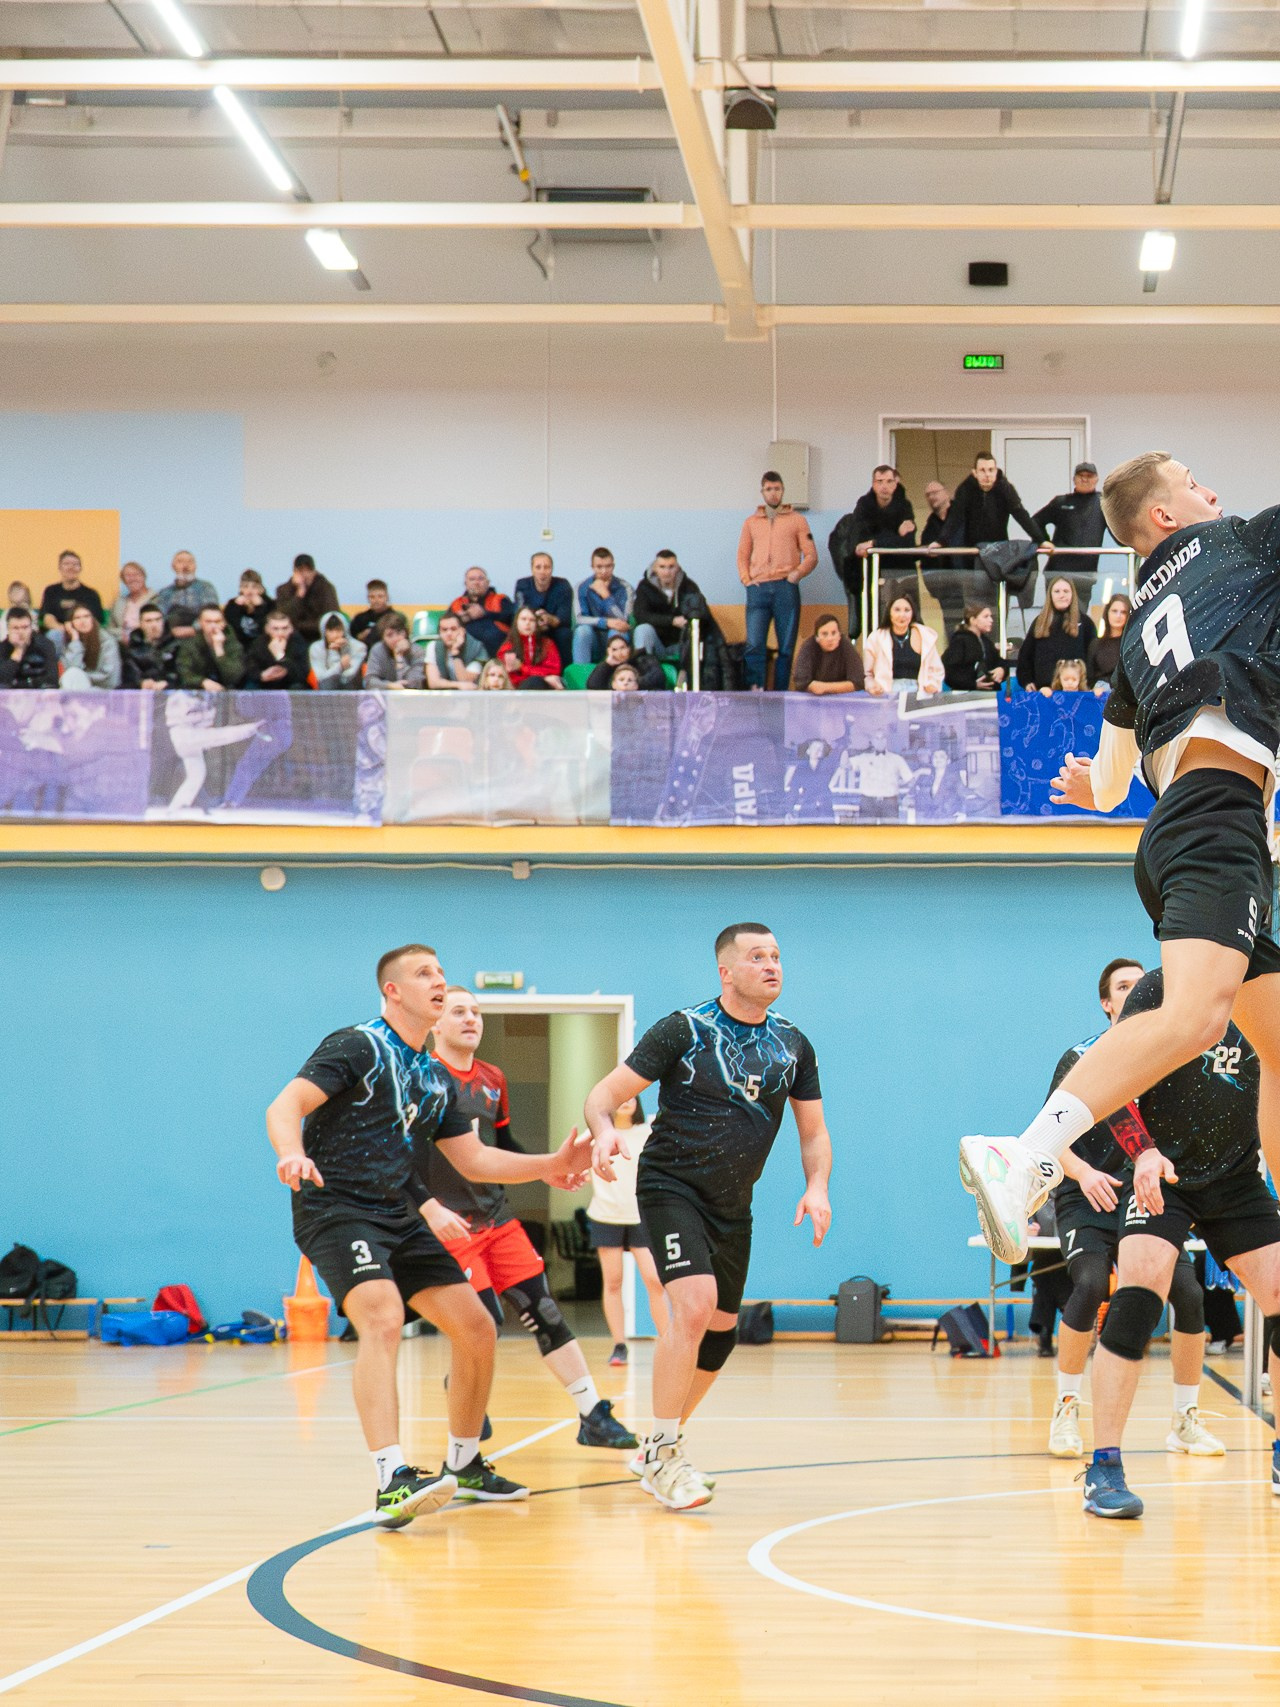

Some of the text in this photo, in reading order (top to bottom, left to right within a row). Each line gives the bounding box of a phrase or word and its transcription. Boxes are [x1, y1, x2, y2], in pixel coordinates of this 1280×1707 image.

[1141, 593, 1196, 689] 9
[1213, 1045, 1242, 1075] 22
[746, 1075, 761, 1101] 5
[351, 1239, 373, 1265] 3
[665, 1232, 681, 1261] 5
[1065, 1228, 1077, 1251] 7
